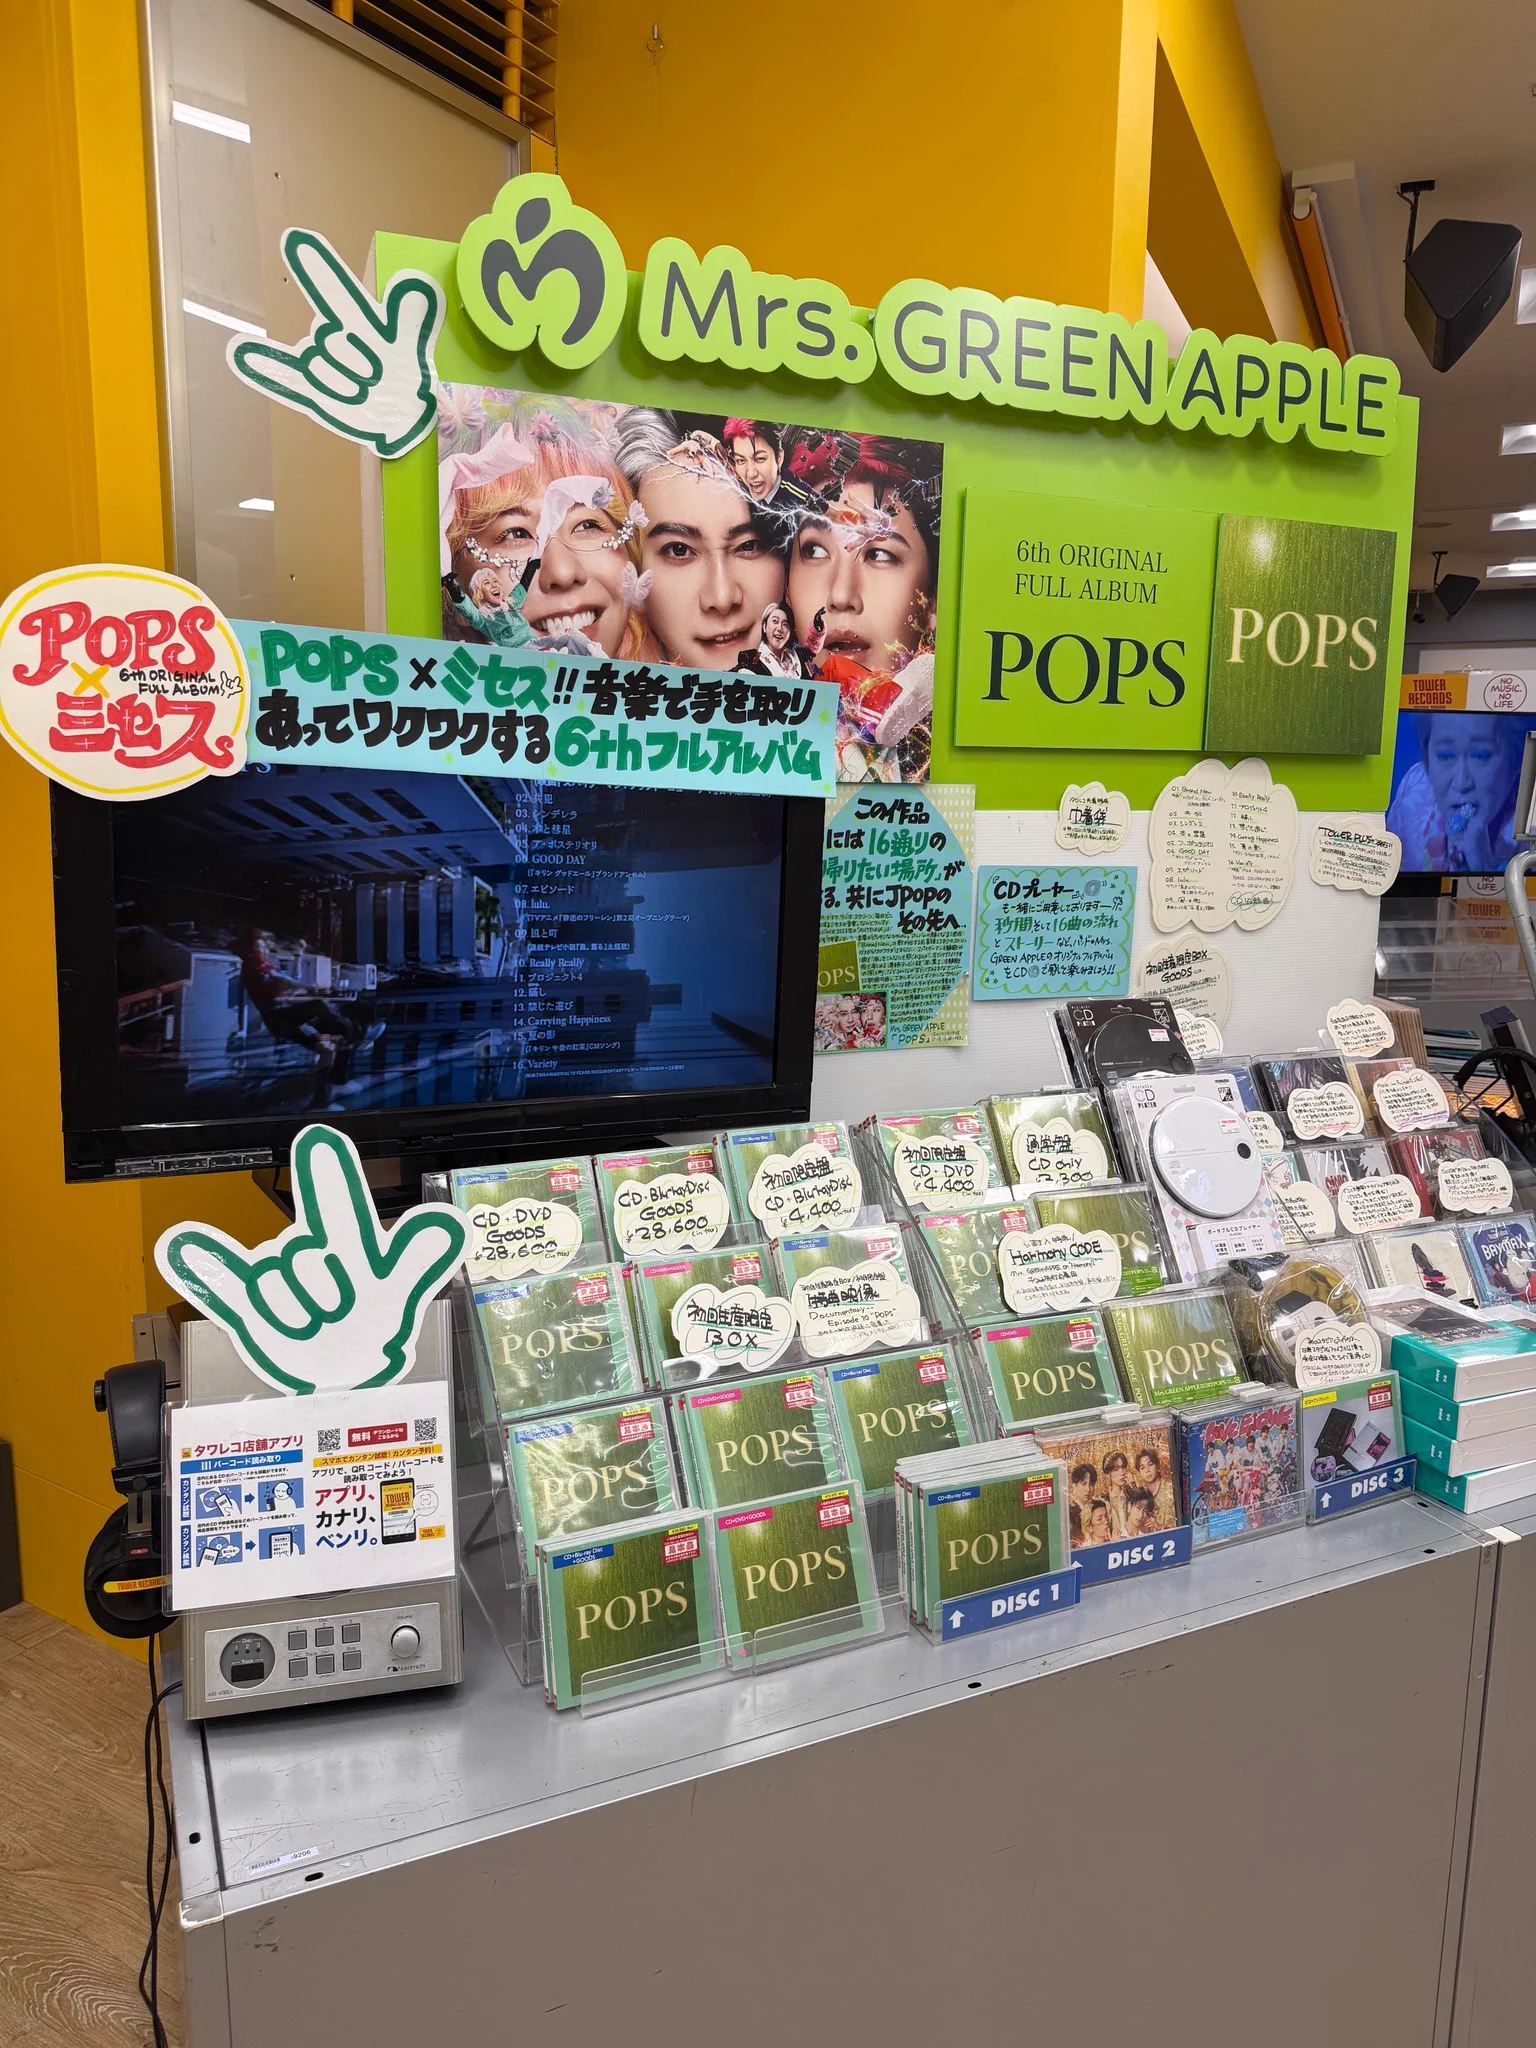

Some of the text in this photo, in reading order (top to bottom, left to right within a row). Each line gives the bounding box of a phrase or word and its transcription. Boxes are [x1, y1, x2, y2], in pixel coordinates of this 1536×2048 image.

[660, 259, 1389, 439] Mrs. GREEN APPLE
[1017, 539, 1168, 574] 6th ORIGINAL
[1015, 573, 1157, 605] FULL ALBUM
[13, 601, 216, 687] POPS
[1226, 606, 1378, 671] POPS
[119, 668, 216, 684] 6th ORIGINAL
[981, 630, 1186, 708] POPS
[138, 682, 219, 697] FULL ALBUM
[1412, 678, 1447, 691] TOWER
[1500, 677, 1514, 686] NO
[1408, 691, 1453, 706] RECORDS
[1498, 692, 1512, 701] NO
[532, 809, 578, 820] シンデレラ
[854, 798, 930, 826] この作品
[531, 854, 563, 865] GOOD
[566, 854, 587, 866] DAY
[1467, 903, 1501, 916] TOWER
[528, 956, 585, 971] Really Really
[990, 953, 1017, 965] GREEN
[817, 966, 856, 988] OPS
[1161, 966, 1193, 984] GOODS
[527, 1014, 612, 1028] Carrying Happiness
[1073, 1009, 1094, 1021] CD
[527, 1059, 559, 1071] Variety
[1134, 1088, 1156, 1101] CD
[1028, 1157, 1051, 1171] CD
[639, 1200, 694, 1222] GOODS
[486, 1225, 546, 1245] GOODS
[1007, 1239, 1103, 1266] Harmony CODE
[808, 1306, 866, 1320] Documentary
[827, 1317, 859, 1327] Episode
[500, 1318, 603, 1365] POPS
[705, 1328, 758, 1350] BOX
[1141, 1338, 1237, 1380] POPS
[1010, 1360, 1097, 1402] POPS
[697, 1391, 736, 1405] CD+DVD+GOODS
[857, 1398, 948, 1443] POPS
[352, 1431, 371, 1443] 無料
[373, 1427, 404, 1436] ダウンロードは
[194, 1435, 303, 1458] タワレコ店舗アプリ
[715, 1424, 813, 1473] POPS
[213, 1454, 282, 1469] バーコード読み取り
[343, 1468, 412, 1484] 読み取ってみよう！
[1351, 1467, 1404, 1499] DISC 3
[541, 1459, 648, 1512] POPS
[963, 1489, 972, 1498] Disc
[315, 1484, 376, 1507] アプリ、
[385, 1491, 410, 1504] TOWER
[315, 1506, 377, 1529] カナリ、
[724, 1511, 767, 1526] CD+DVD+GOODS
[315, 1528, 378, 1549] ベンリ。
[563, 1546, 604, 1561] CD+Blu-ray Disc
[948, 1523, 1043, 1572] POPS
[1107, 1540, 1175, 1570] DISC 2
[572, 1555, 596, 1565] +GOODS
[741, 1544, 847, 1601] POPS
[117, 1578, 165, 1590] TOWER RECORDS
[991, 1583, 1060, 1618] DISC 1
[576, 1580, 689, 1641] POPS
